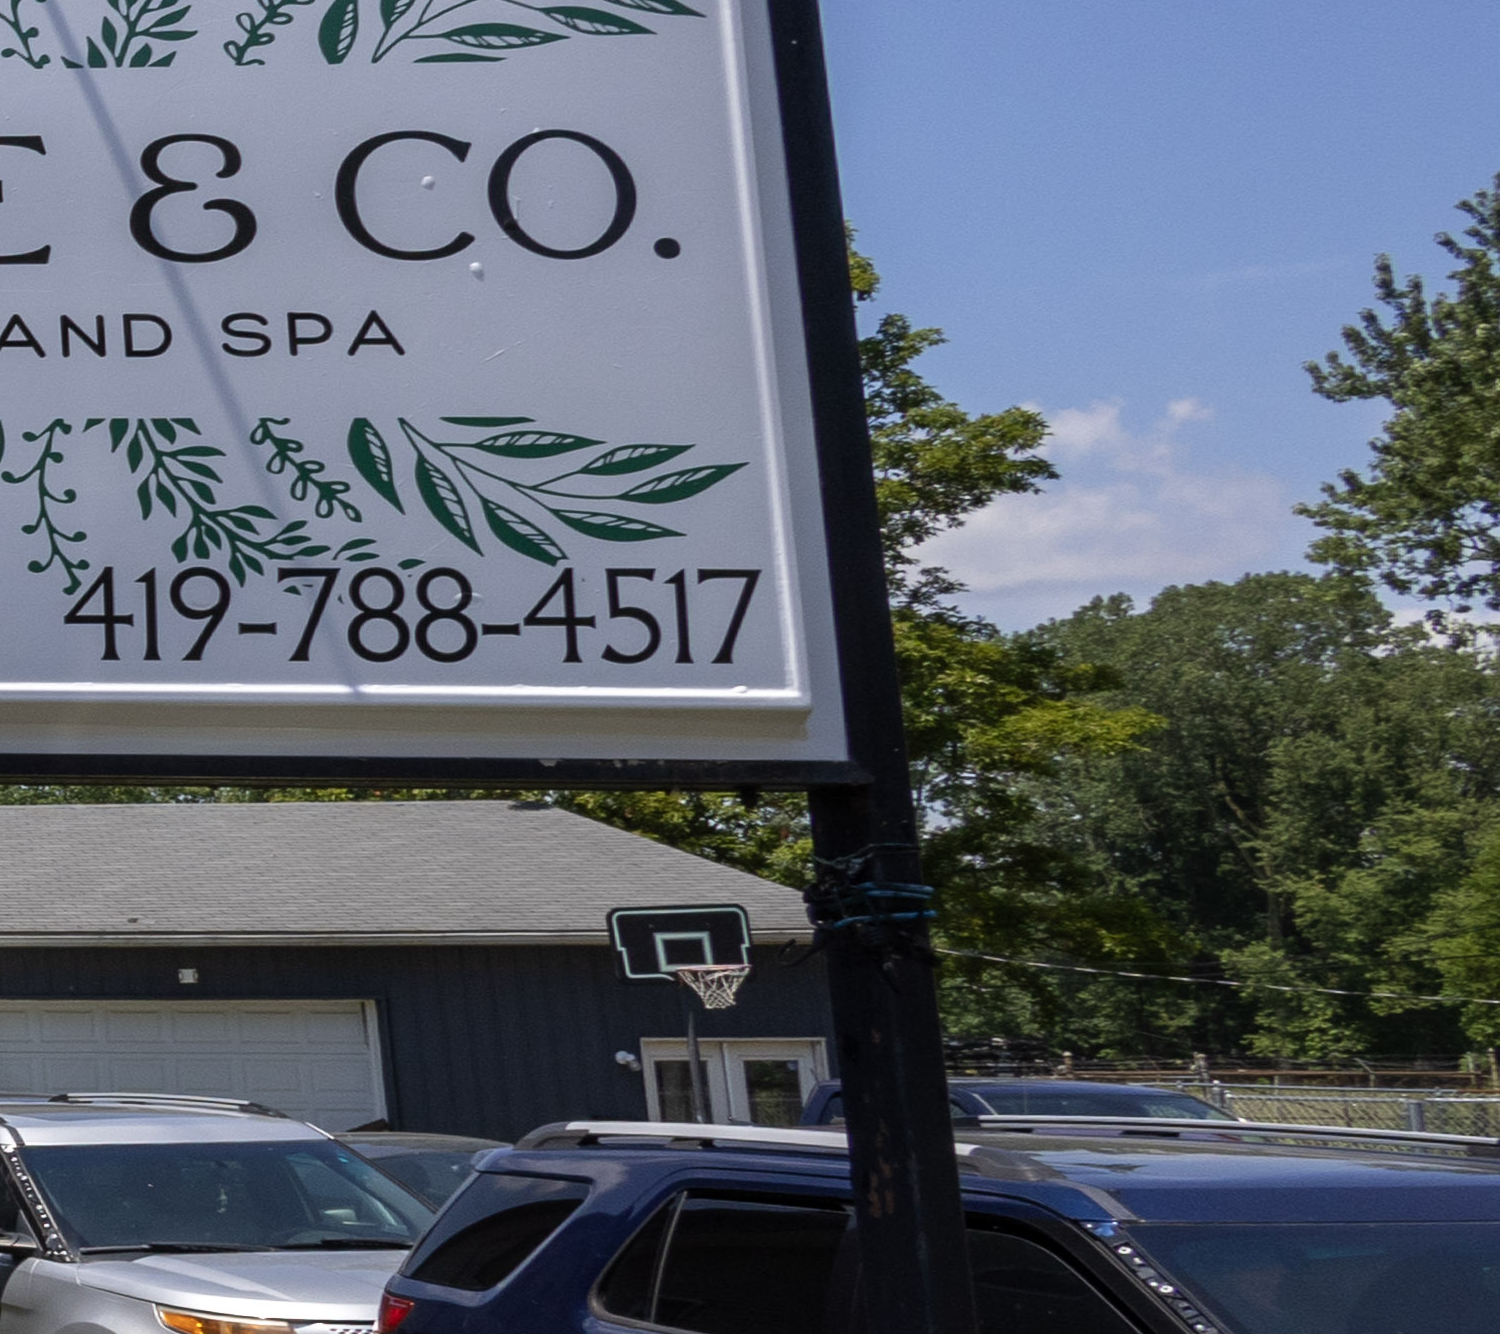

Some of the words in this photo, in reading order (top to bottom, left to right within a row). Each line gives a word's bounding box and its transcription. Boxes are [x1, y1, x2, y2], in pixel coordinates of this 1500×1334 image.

[129, 133, 258, 264] &
[334, 129, 681, 261] CO.
[221, 310, 406, 358] SPA
[63, 566, 762, 665] 419-788-4517
